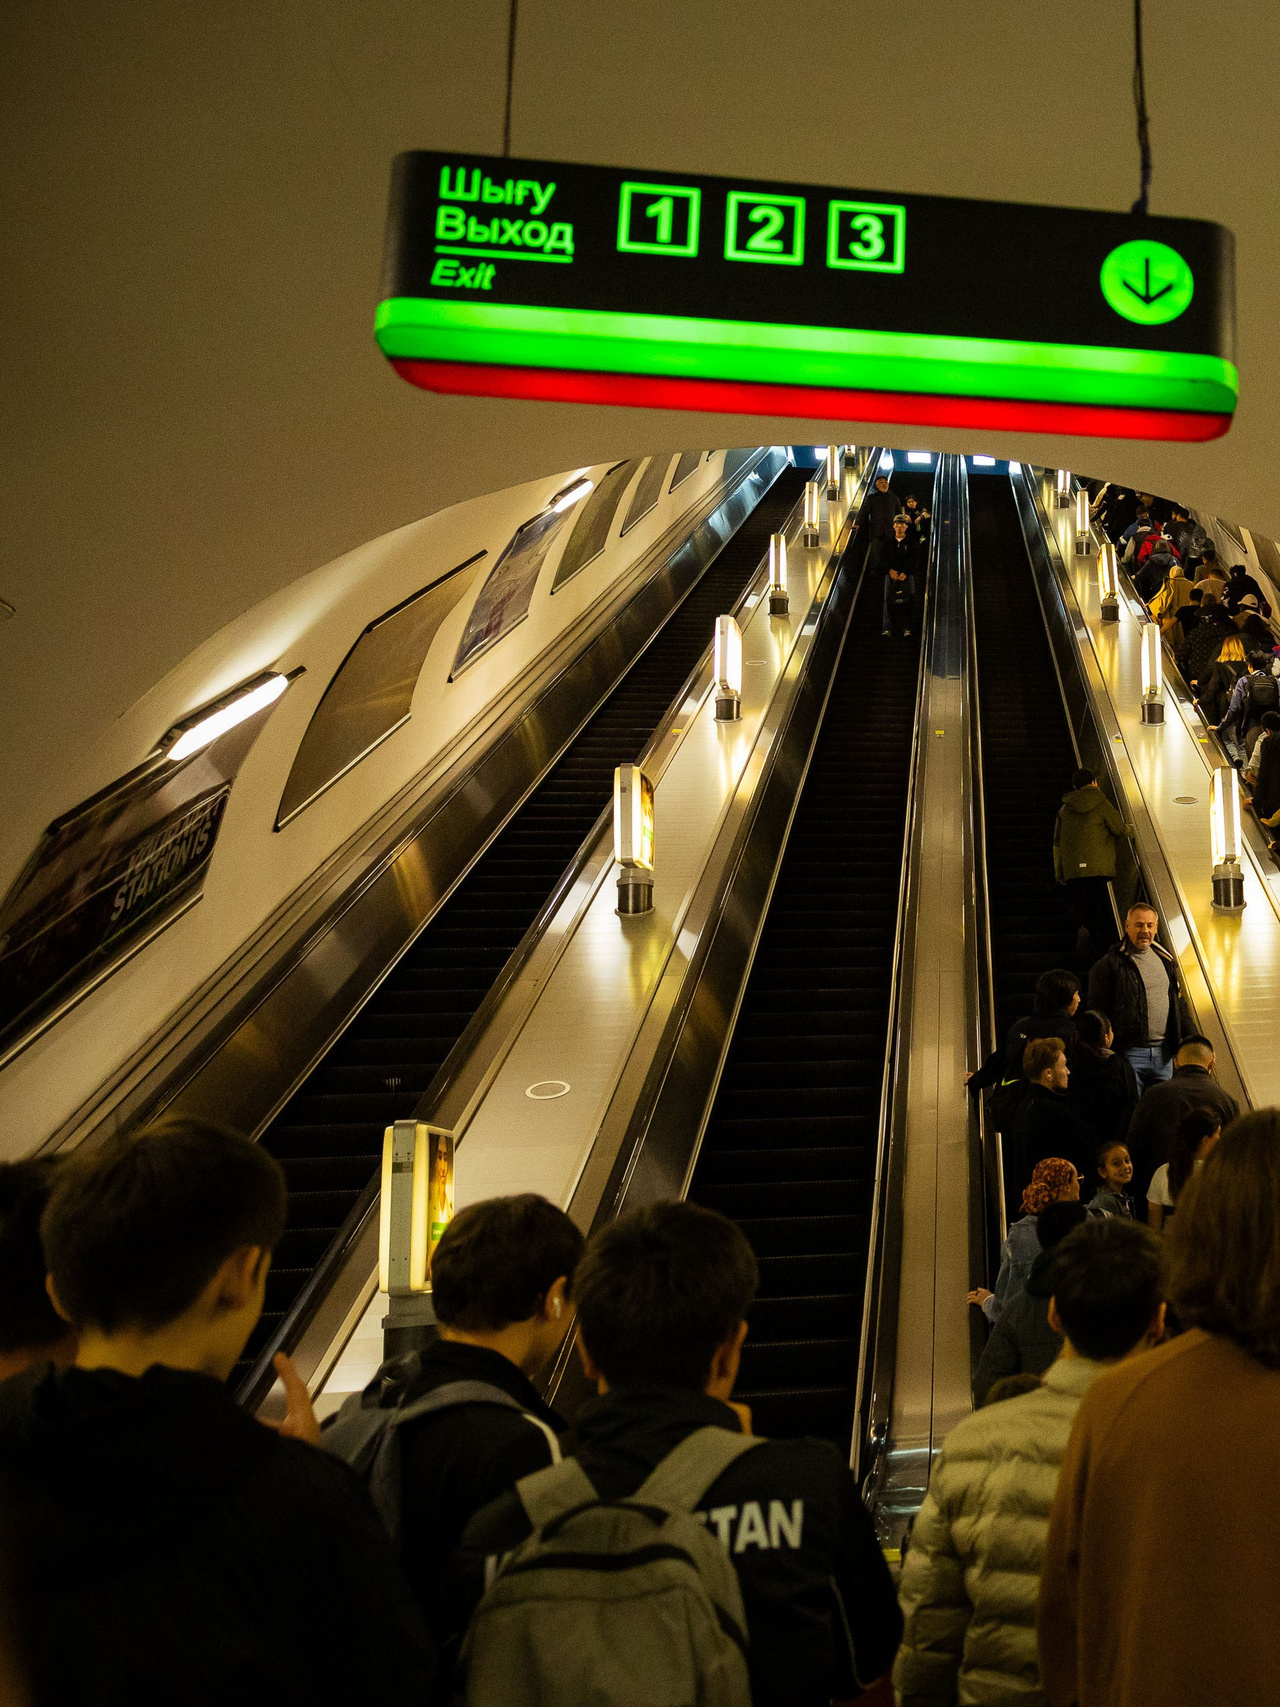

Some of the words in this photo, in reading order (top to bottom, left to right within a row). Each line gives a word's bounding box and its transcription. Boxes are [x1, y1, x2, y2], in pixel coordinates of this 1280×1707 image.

[438, 165, 557, 216] Шығу
[434, 204, 575, 256] Выход
[645, 196, 675, 243] 1
[748, 205, 784, 252] 2
[849, 213, 884, 260] 3
[429, 258, 497, 291] Exit
[110, 834, 194, 922] STATION
